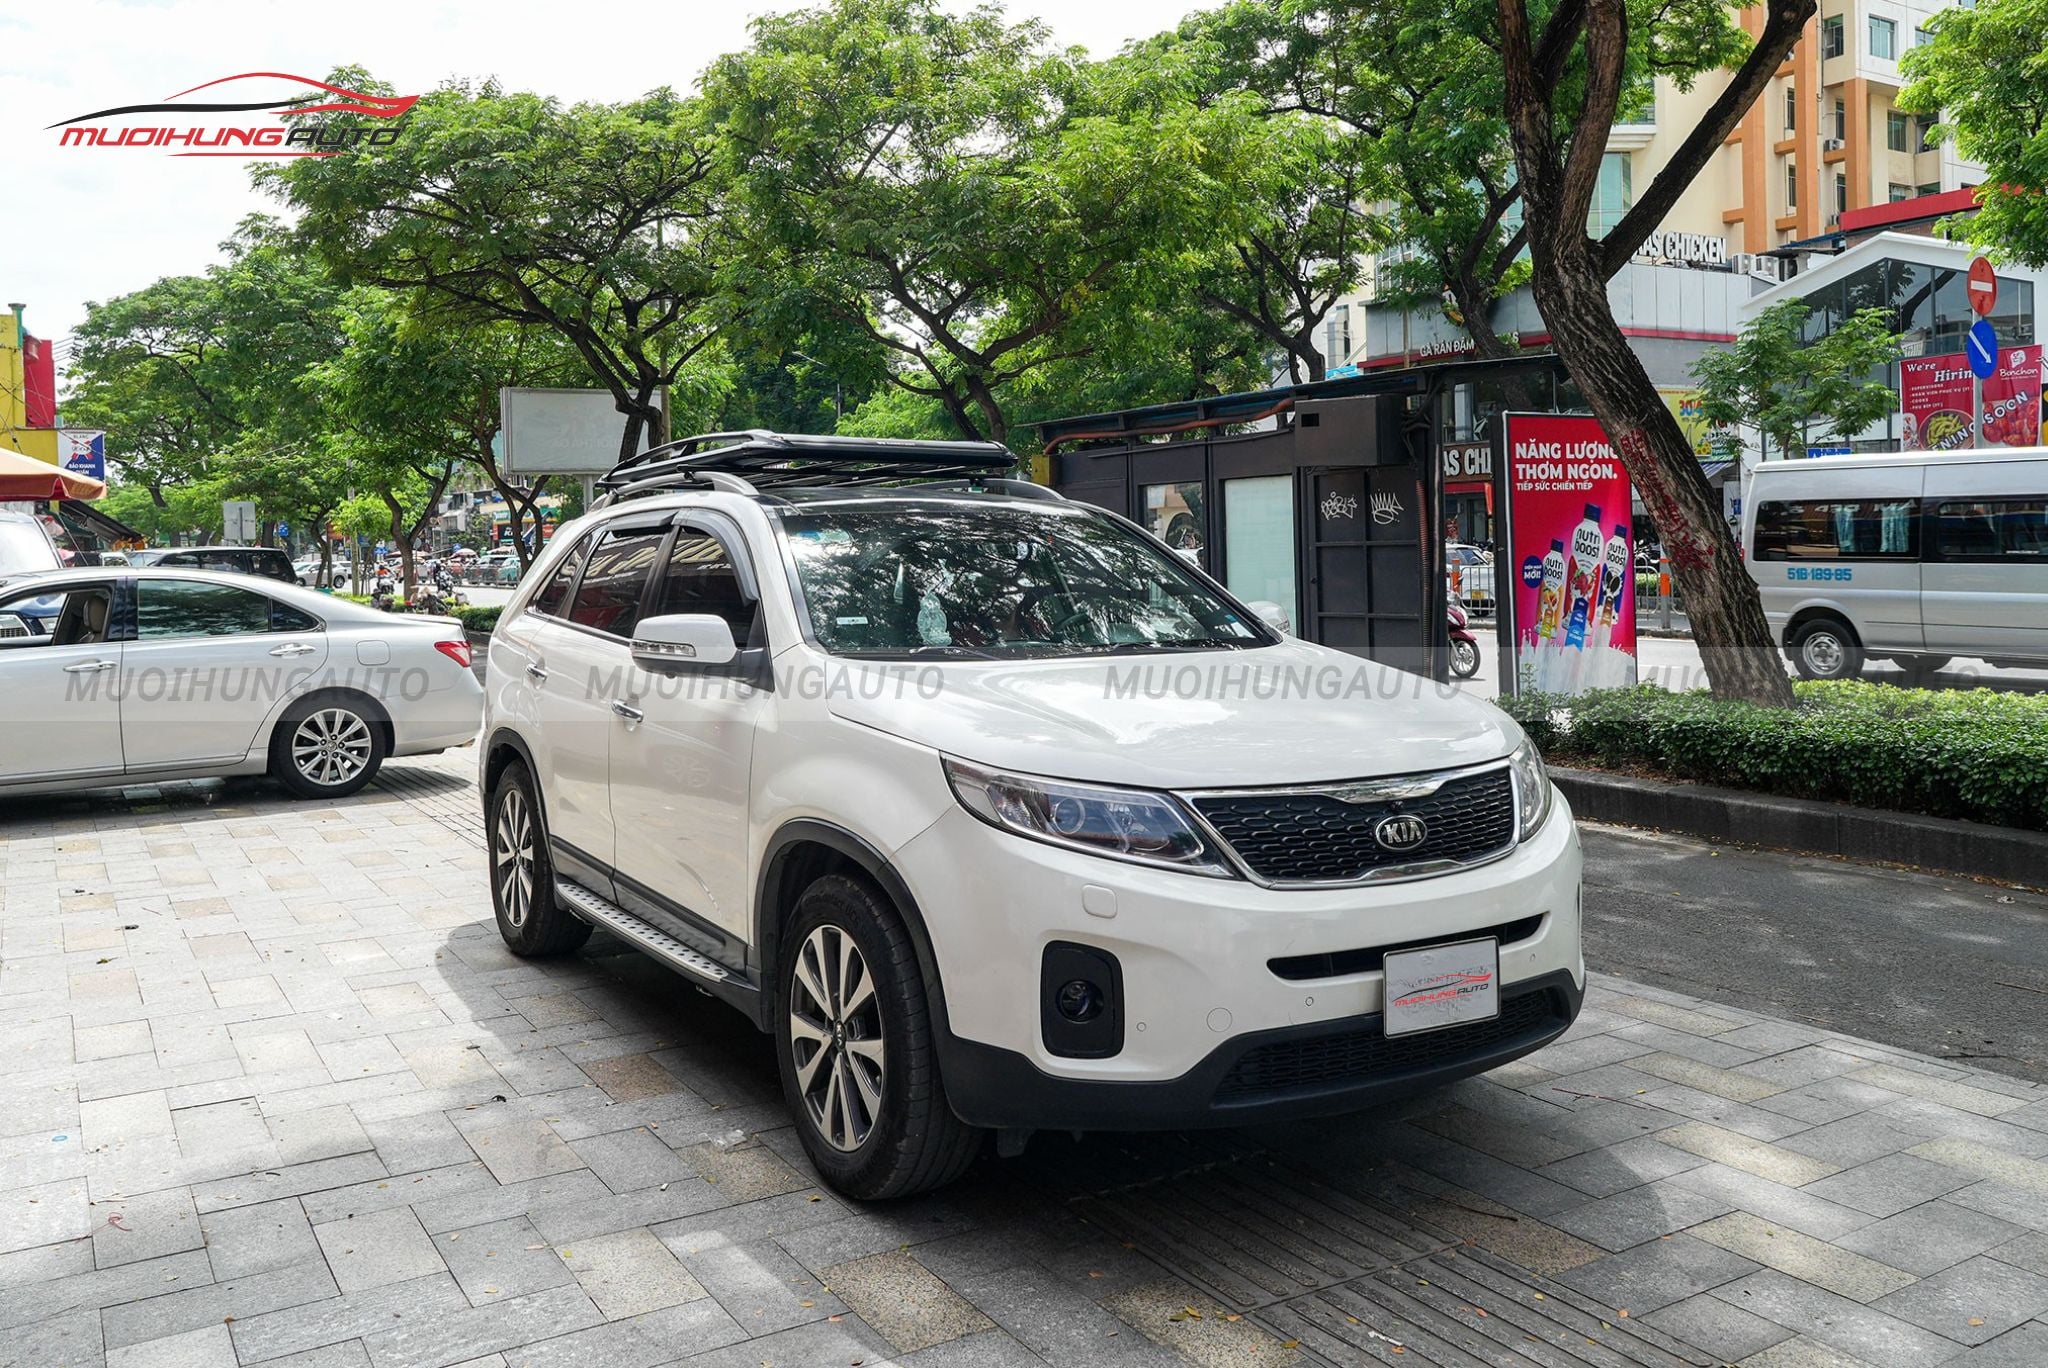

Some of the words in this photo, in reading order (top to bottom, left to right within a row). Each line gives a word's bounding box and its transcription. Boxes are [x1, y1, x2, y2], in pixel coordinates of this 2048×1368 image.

[1665, 232, 1727, 264] CHICKEN
[1907, 363, 1936, 372] We're
[1934, 368, 1973, 382] Hirin
[1515, 438, 1561, 459] NĂNG
[1515, 461, 1562, 479] THƠM
[1567, 464, 1617, 479] NGON.
[1516, 480, 1533, 490] TIẾP
[1535, 480, 1550, 490] SỨC
[1551, 480, 1575, 490] CHIẾN
[1576, 480, 1593, 490] TIẾP
[1385, 821, 1422, 844] KIA
